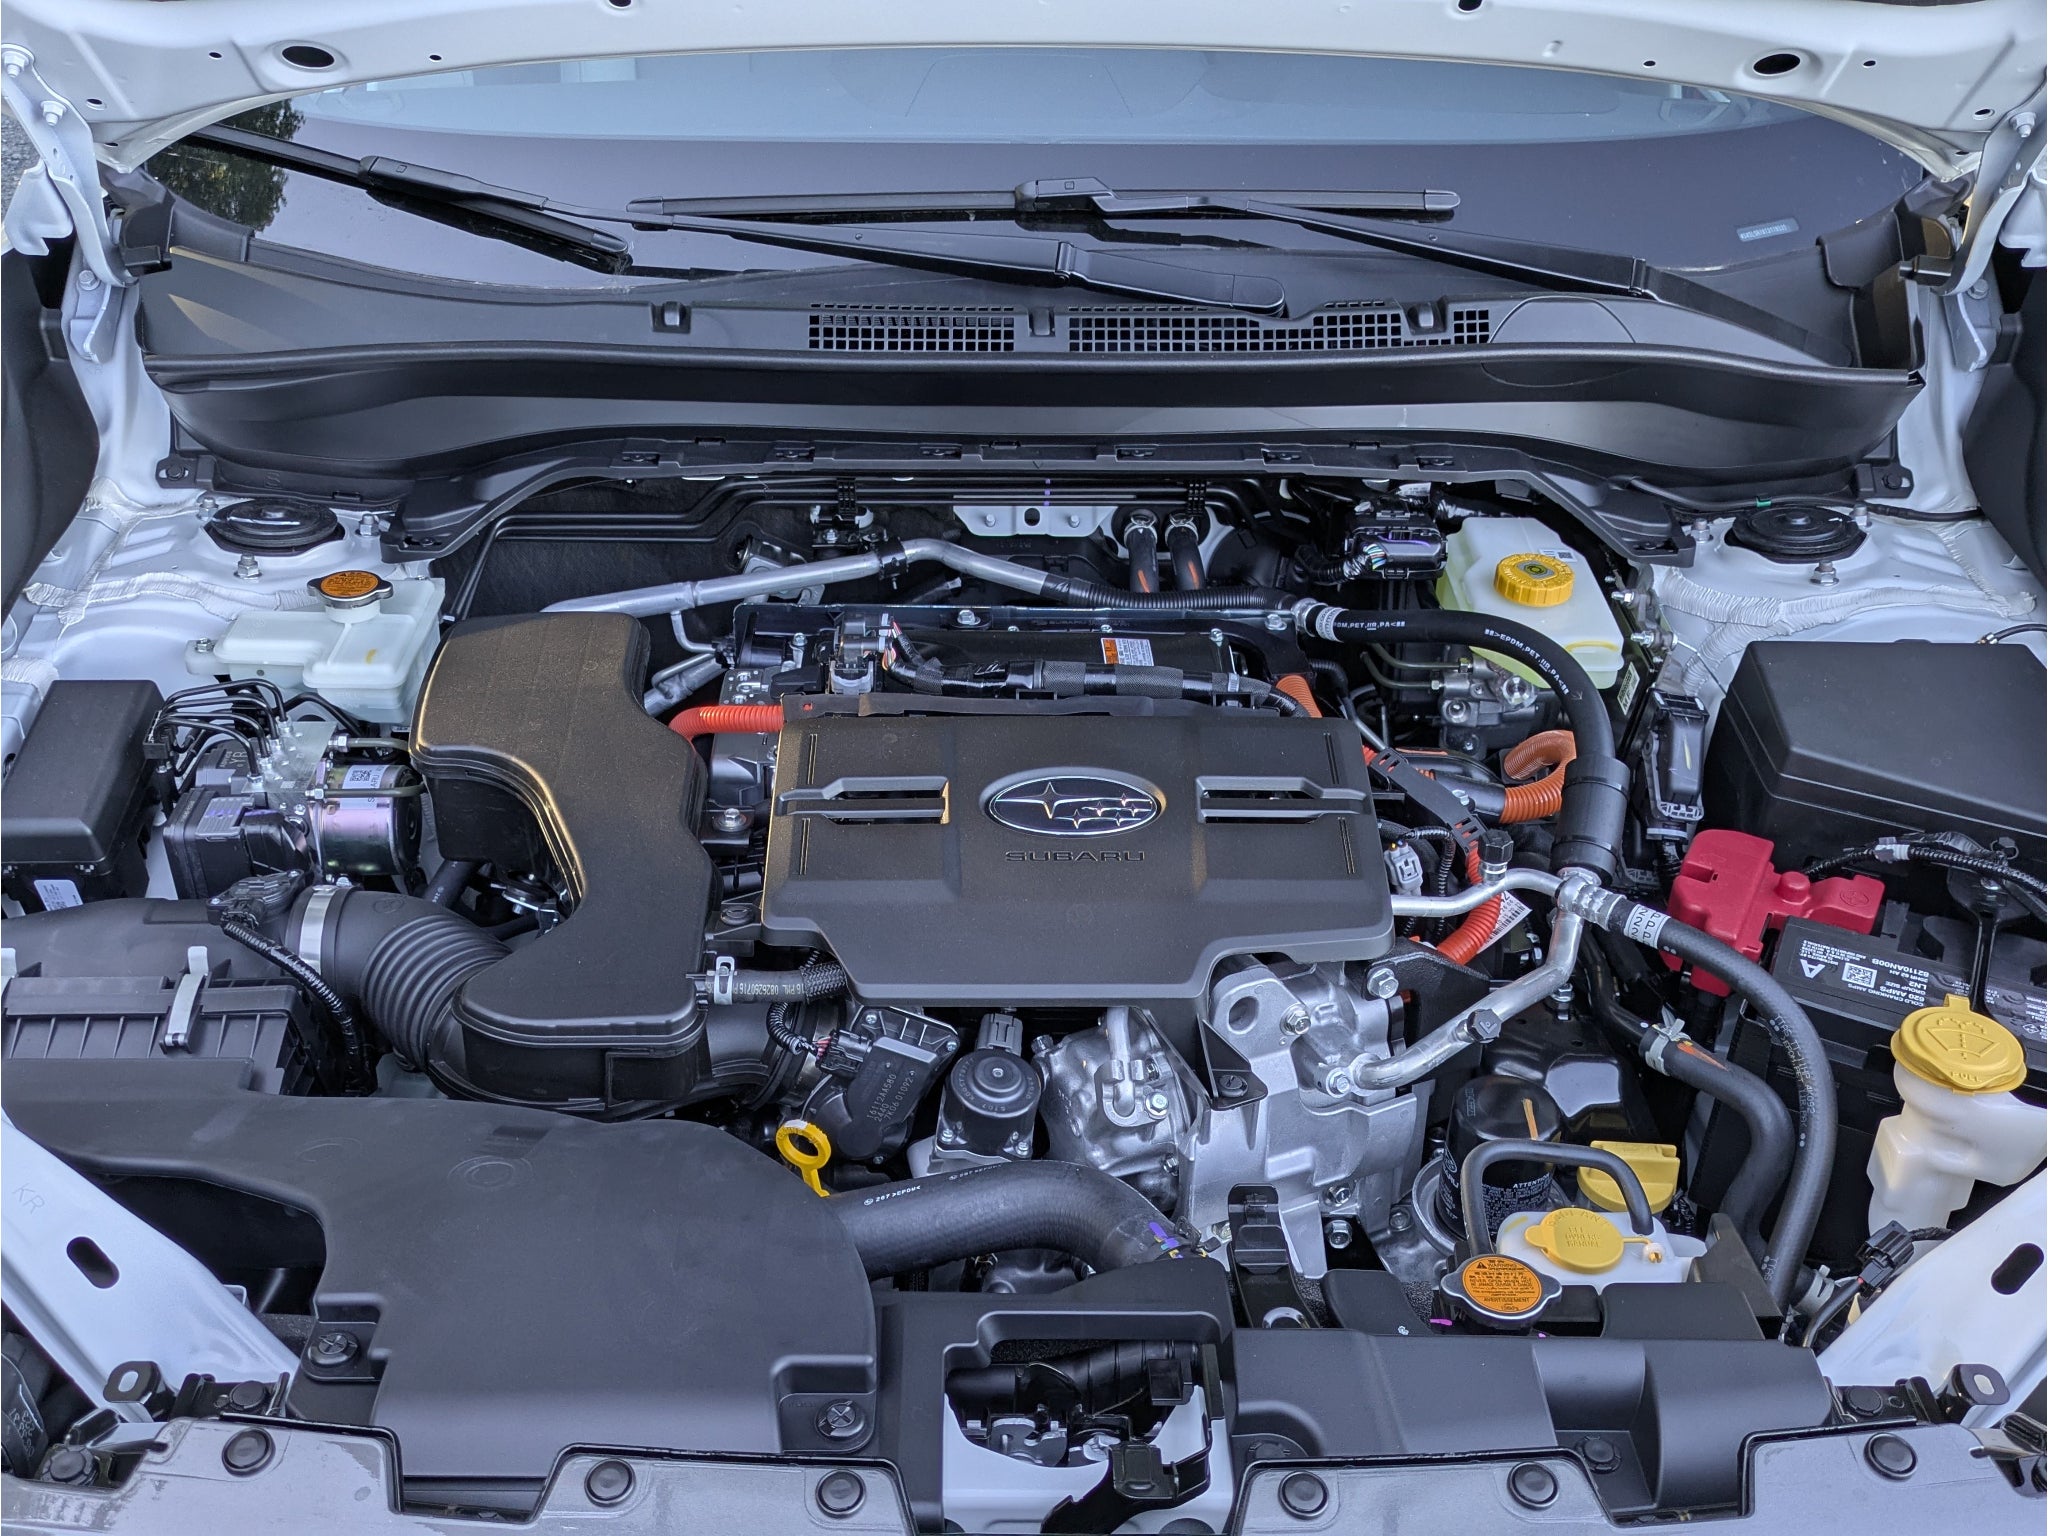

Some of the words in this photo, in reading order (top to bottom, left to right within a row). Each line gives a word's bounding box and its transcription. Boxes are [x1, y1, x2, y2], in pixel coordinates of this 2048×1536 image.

[1004, 850, 1146, 862] SUBARU
[1909, 981, 1927, 990] LN2
[1880, 986, 1906, 997] AMPS
[1904, 998, 1924, 1007] COLD
